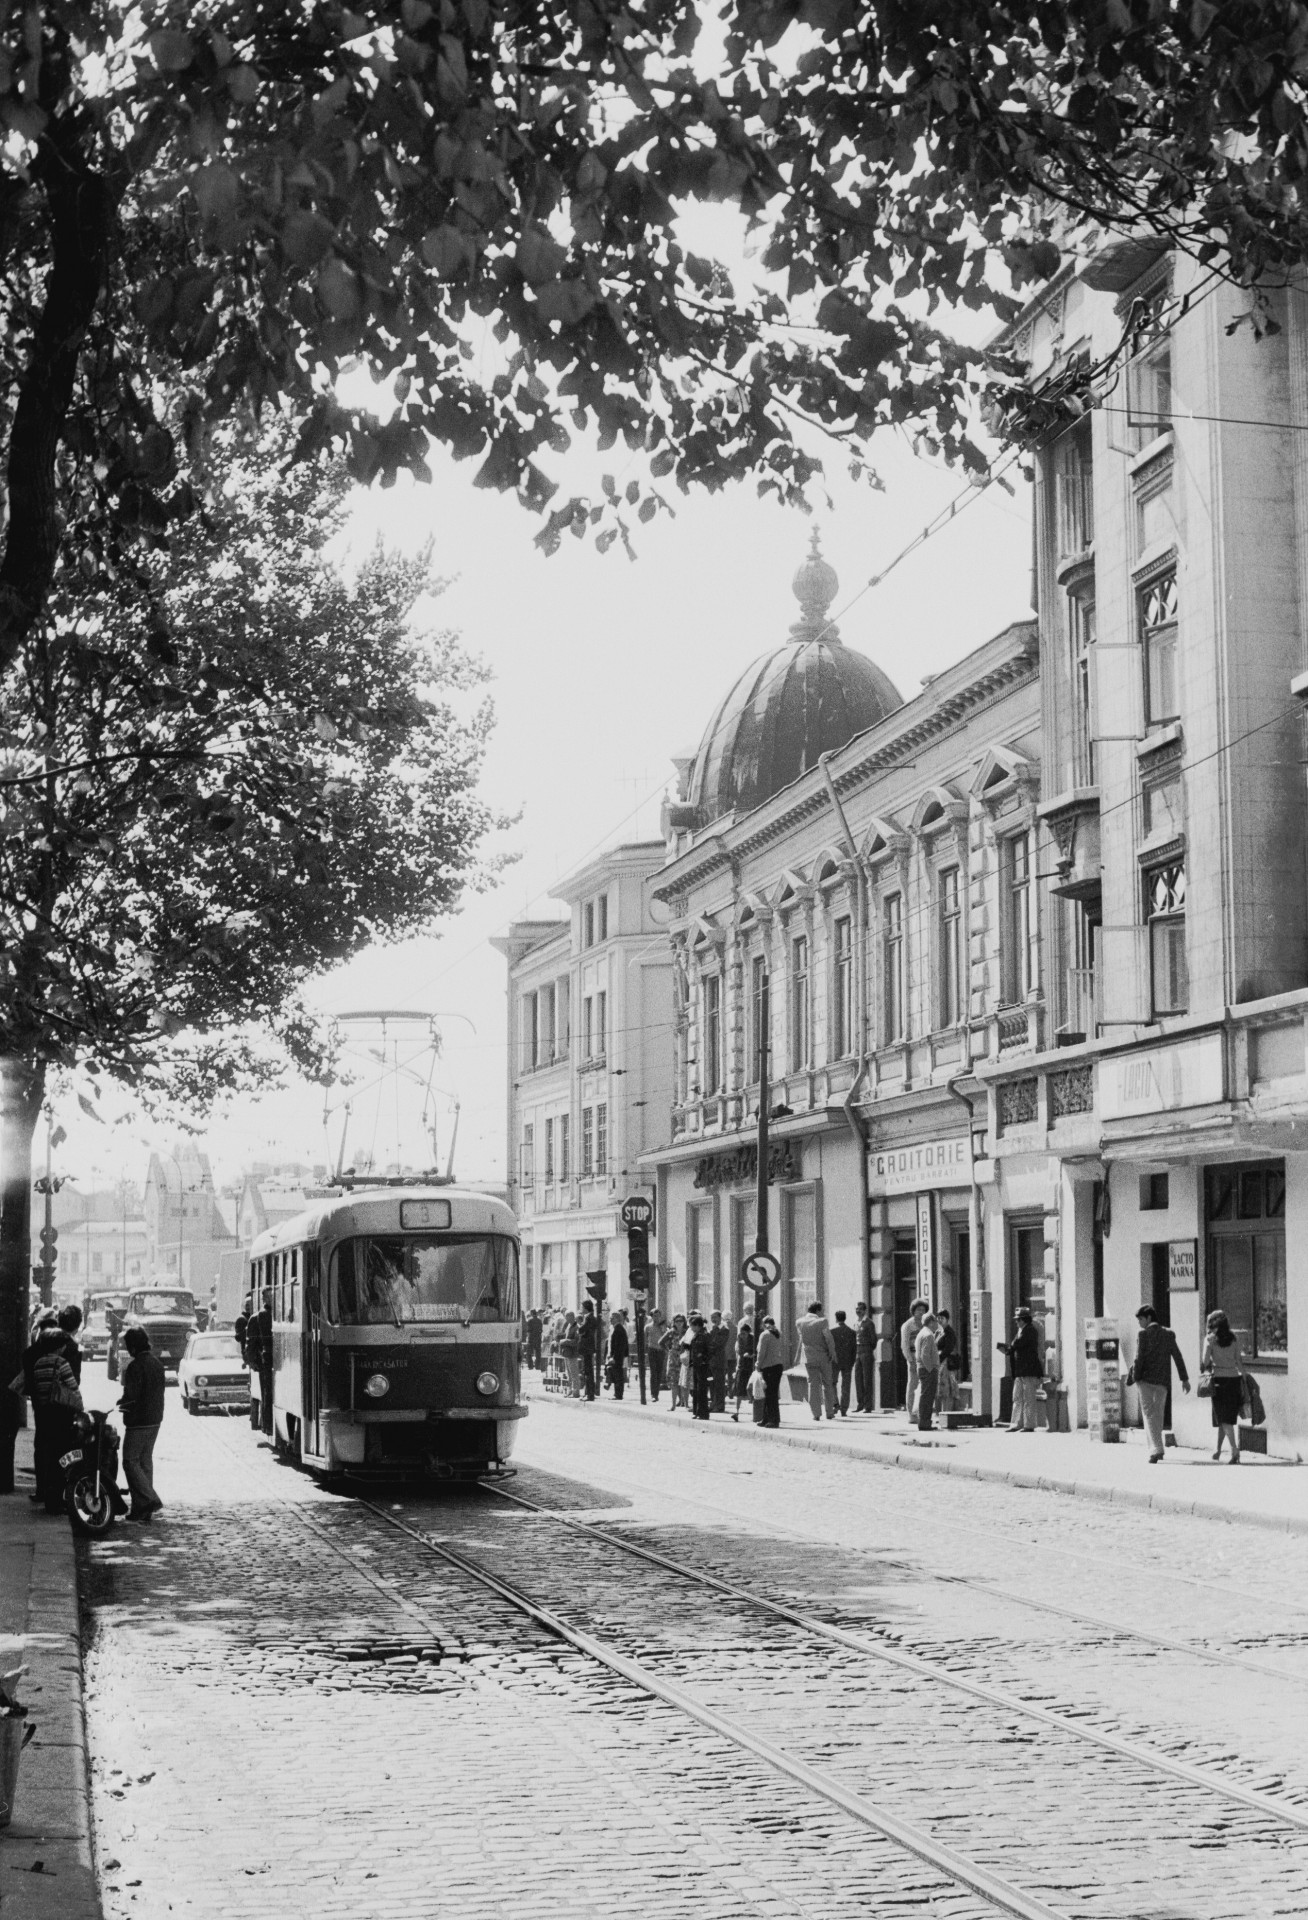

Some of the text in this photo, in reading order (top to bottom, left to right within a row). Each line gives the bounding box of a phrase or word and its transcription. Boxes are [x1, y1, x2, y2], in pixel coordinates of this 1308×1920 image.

[877, 1142, 964, 1175] CROITORIE
[625, 1206, 649, 1220] STOP
[1173, 1252, 1194, 1265] LACTO
[1170, 1266, 1194, 1278] MARNA
